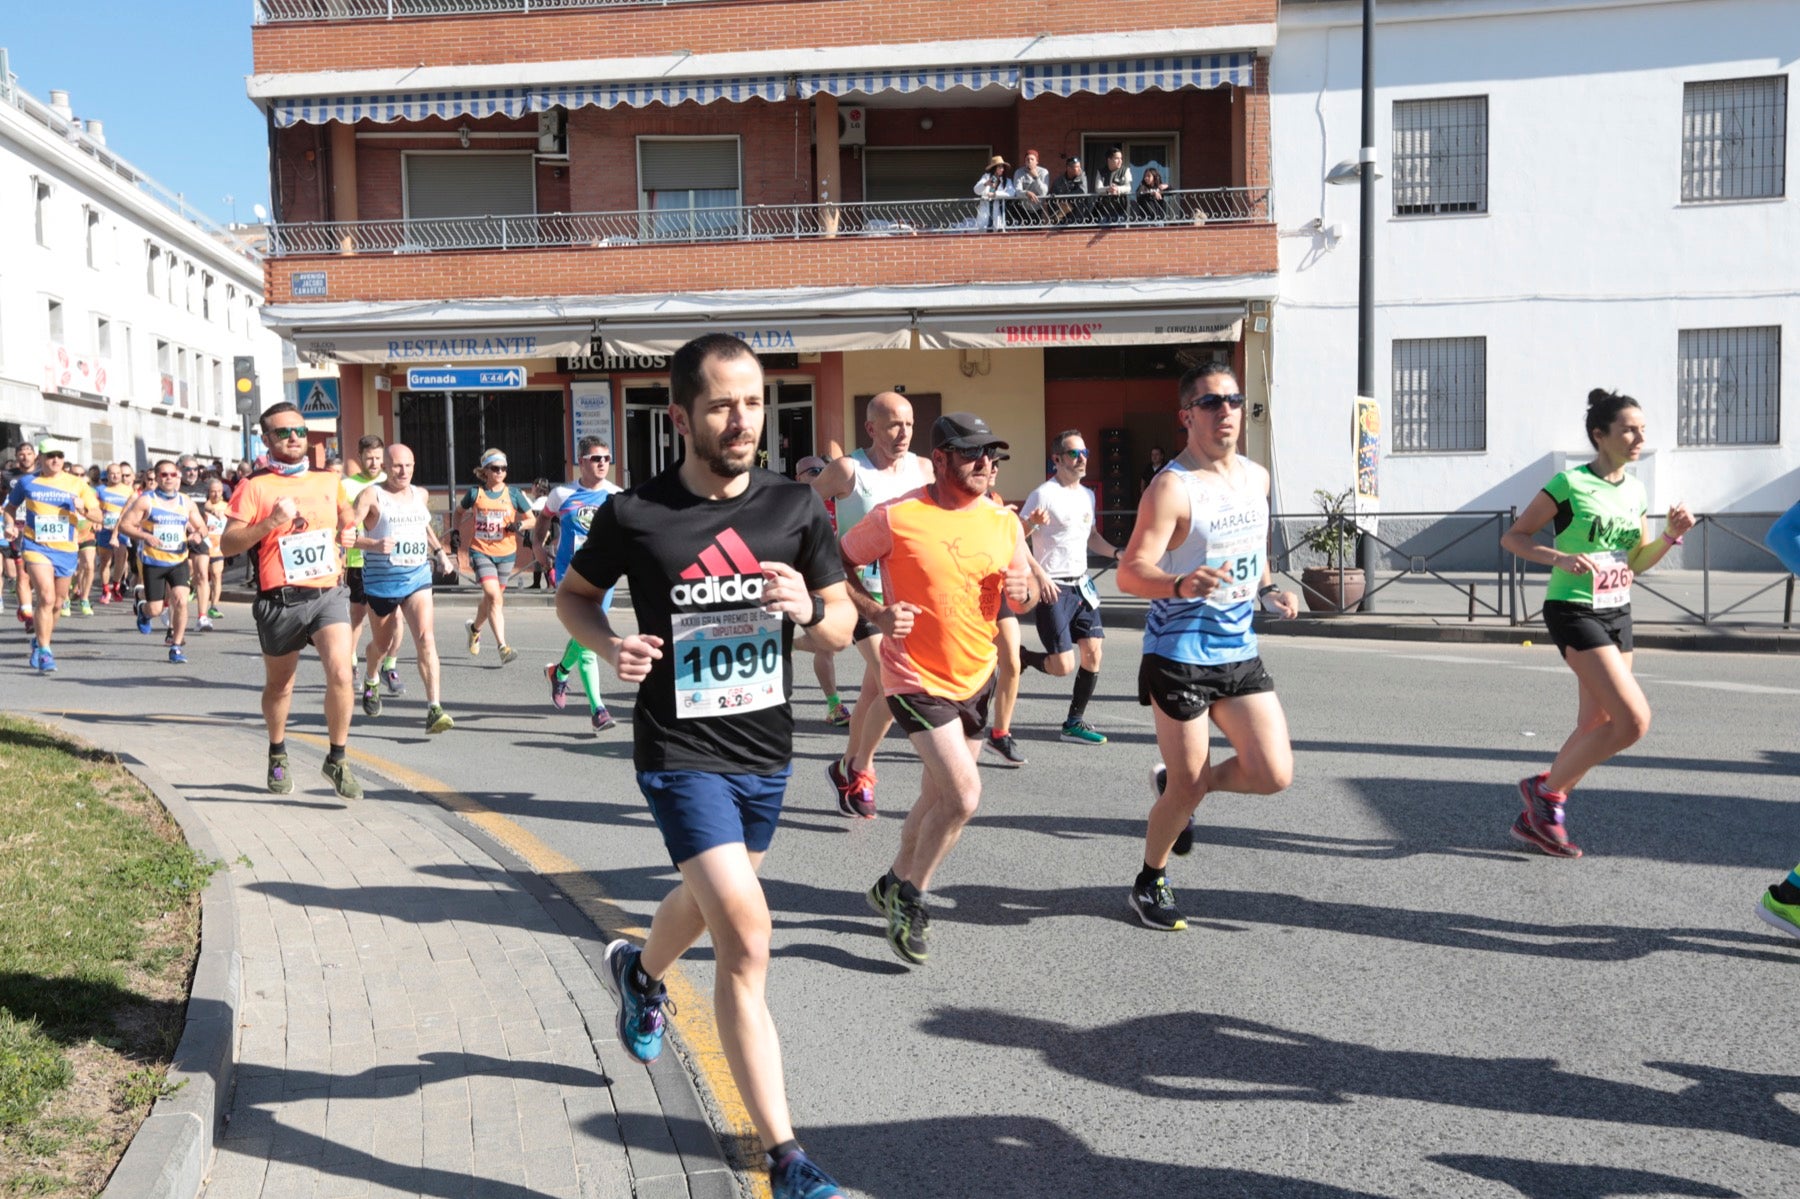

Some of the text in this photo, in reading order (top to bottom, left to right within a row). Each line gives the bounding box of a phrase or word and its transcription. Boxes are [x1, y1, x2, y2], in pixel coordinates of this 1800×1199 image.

[1166, 325, 1198, 333] CERVEZAS
[708, 329, 795, 348] RADA
[387, 336, 537, 358] RESTAURANTE
[567, 354, 666, 370] BICHITOS
[411, 374, 457, 385] Granada
[41, 523, 63, 533] 483
[476, 521, 500, 532] 2251
[160, 532, 179, 542] 498
[395, 541, 426, 555] 1083
[292, 545, 325, 566] 307
[670, 573, 768, 606] adida
[701, 614, 721, 625] GRAN
[722, 612, 749, 624] PREMIO
[750, 611, 758, 622] DE
[683, 638, 778, 683] 1090
